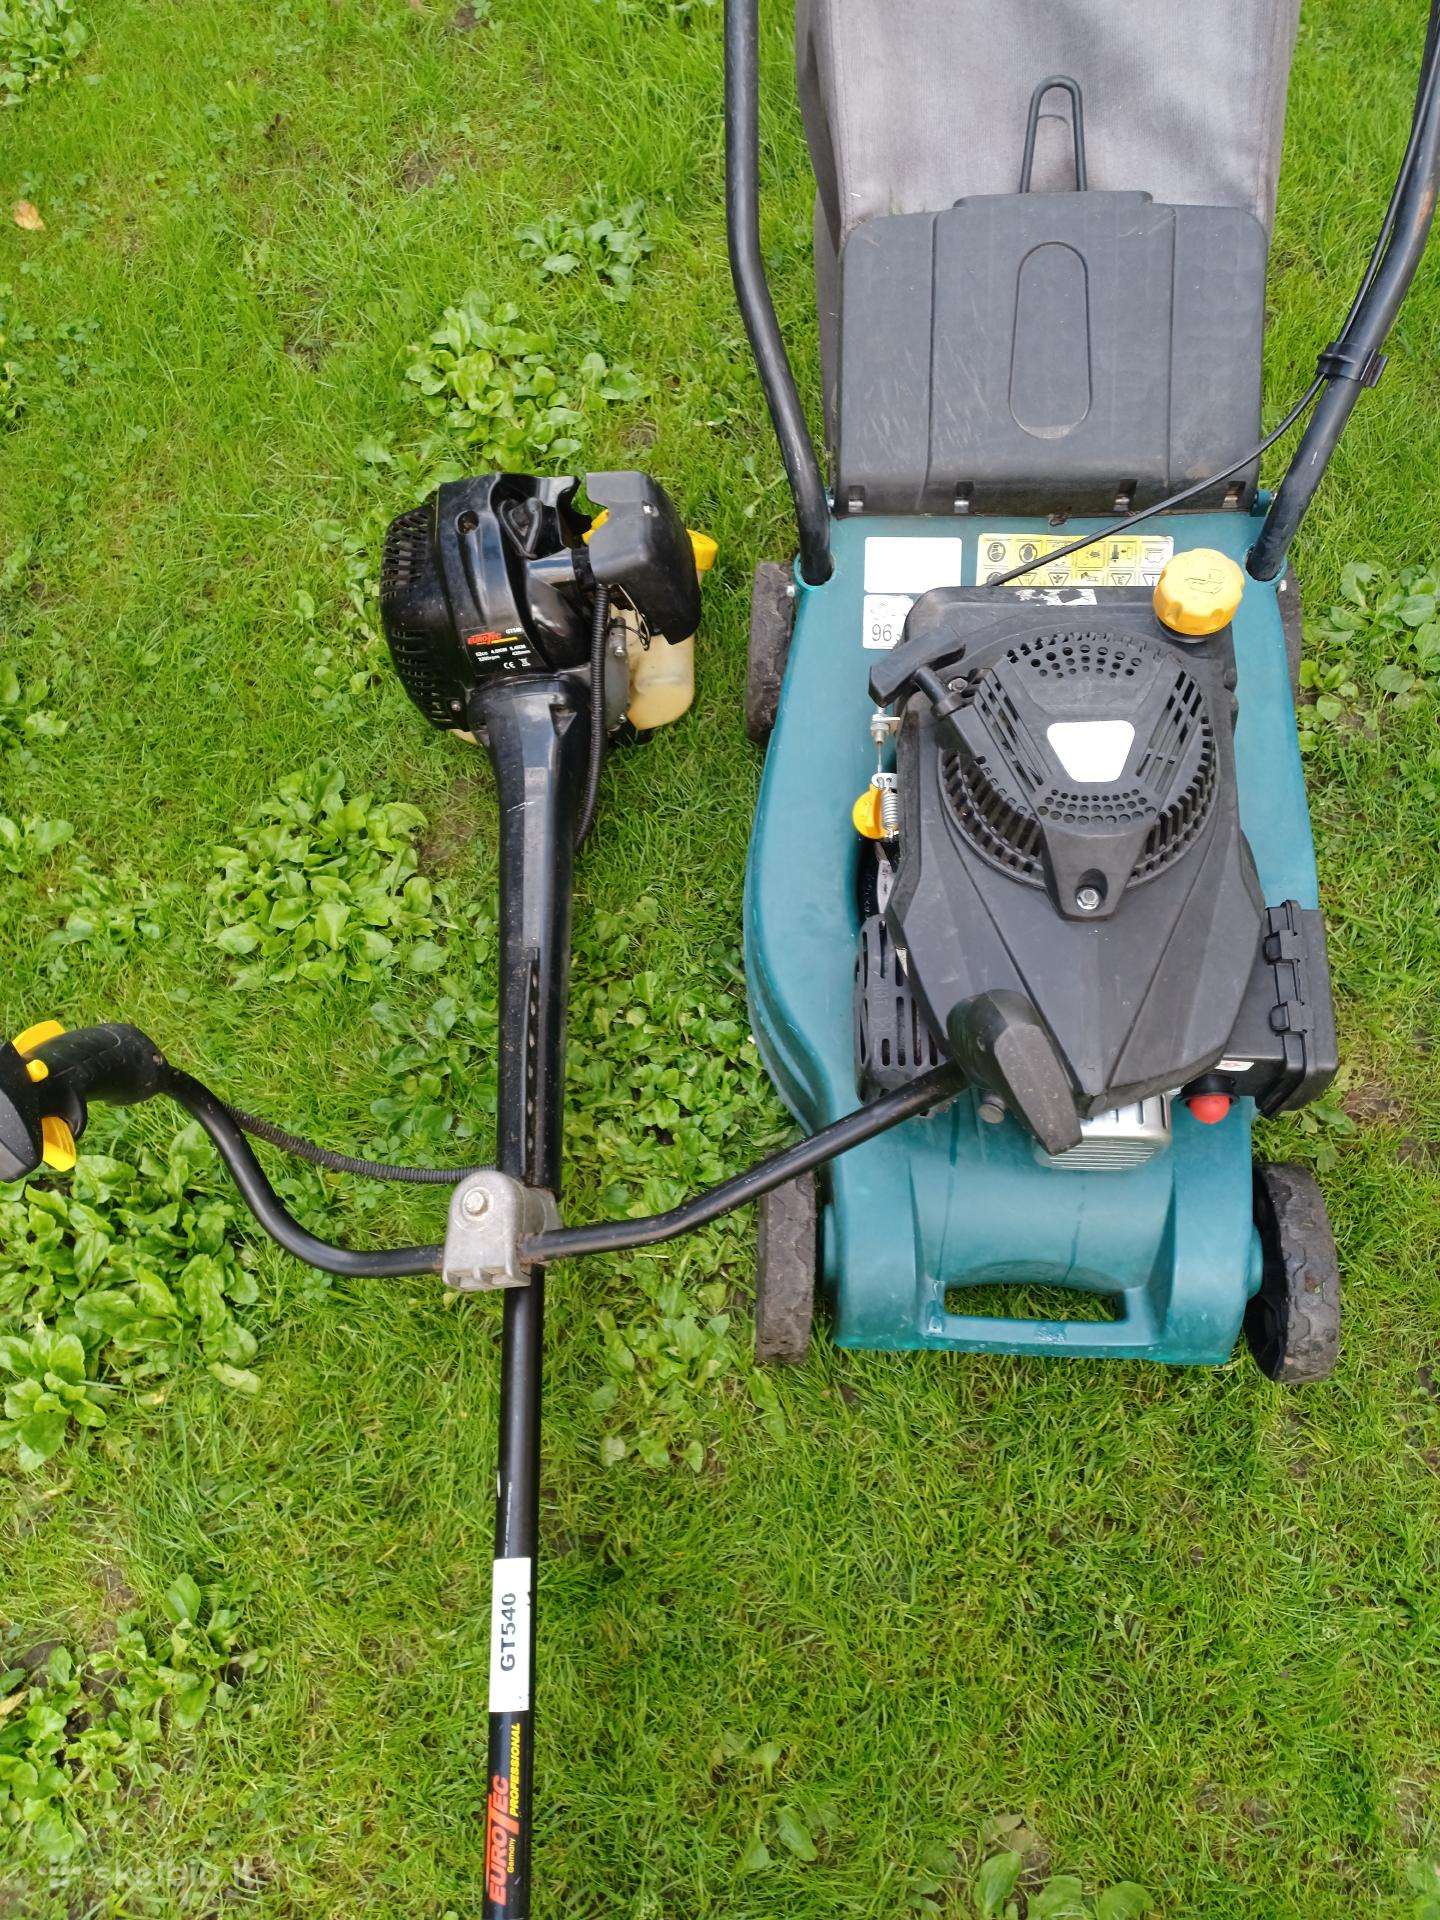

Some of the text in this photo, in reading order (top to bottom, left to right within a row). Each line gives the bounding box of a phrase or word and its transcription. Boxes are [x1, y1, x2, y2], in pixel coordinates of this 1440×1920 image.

[872, 623, 892, 641] 96
[500, 1593, 516, 1672] GT540
[509, 1722, 521, 1817] PROFESSIONAL
[507, 1838, 516, 1873] Germany
